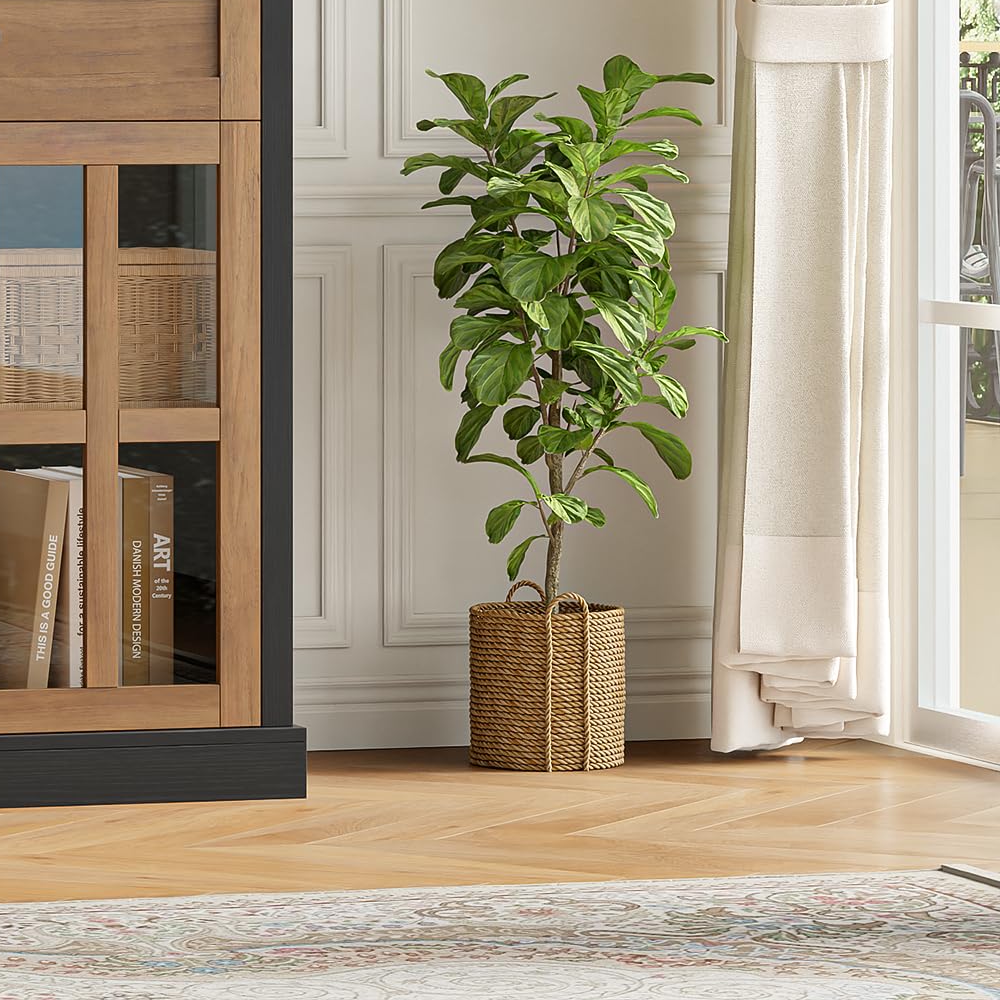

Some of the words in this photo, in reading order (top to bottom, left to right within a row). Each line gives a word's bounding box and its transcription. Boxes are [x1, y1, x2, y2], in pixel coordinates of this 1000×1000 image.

[47, 534, 58, 571] GUIDE
[132, 540, 142, 577] DANISH
[153, 533, 171, 572] ART
[42, 575, 54, 609] GOOD
[132, 580, 142, 622] MODERN
[40, 622, 49, 634] IS
[42, 612, 50, 620] A
[36, 635, 47, 661] THIS
[132, 624, 142, 659] DESIGN
